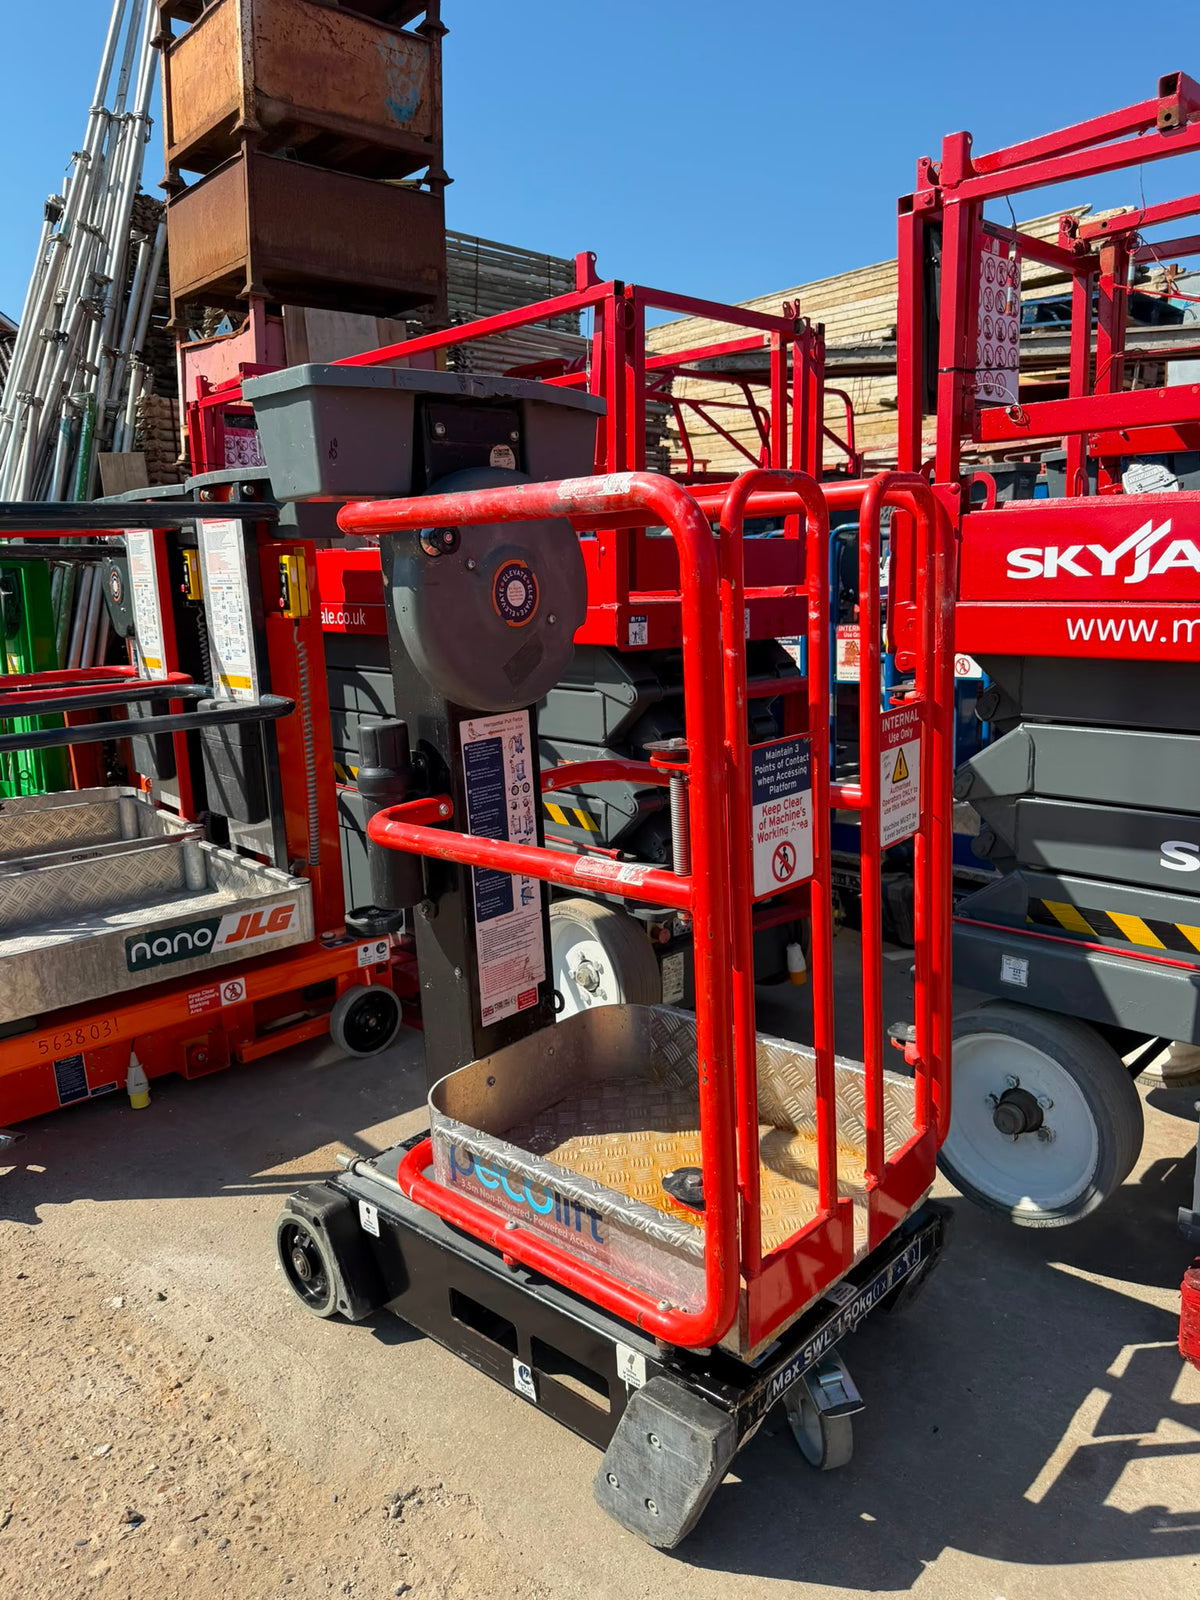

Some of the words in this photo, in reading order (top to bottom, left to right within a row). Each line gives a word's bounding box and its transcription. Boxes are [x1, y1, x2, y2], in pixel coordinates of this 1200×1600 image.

[502, 569, 528, 582] ELEVATE
[882, 708, 919, 732] INTERNAL
[888, 731, 900, 743] Use
[900, 727, 914, 740] Only
[765, 745, 794, 760] Maintain
[794, 743, 800, 753] 3
[754, 763, 776, 775] Points
[777, 759, 784, 769] of
[785, 752, 810, 767] Contact
[757, 775, 775, 787] when
[776, 765, 808, 781] Accessing
[769, 780, 798, 795] Platform
[761, 802, 781, 817] Keep
[783, 796, 803, 810] Clear
[758, 817, 767, 830] of
[768, 807, 807, 827] Machine's
[756, 825, 789, 844] Working
[224, 903, 296, 945] JLG
[130, 927, 214, 964] nano
[188, 992, 201, 1000] Keep
[201, 987, 215, 996] Clear
[189, 1000, 210, 1010] Working
[190, 1007, 203, 1015] Area
[460, 1178, 480, 1194] 3.5m
[533, 1214, 570, 1238] Powered
[569, 1230, 599, 1253] Access
[772, 1360, 801, 1396] Max
[803, 1330, 832, 1365] SWL
